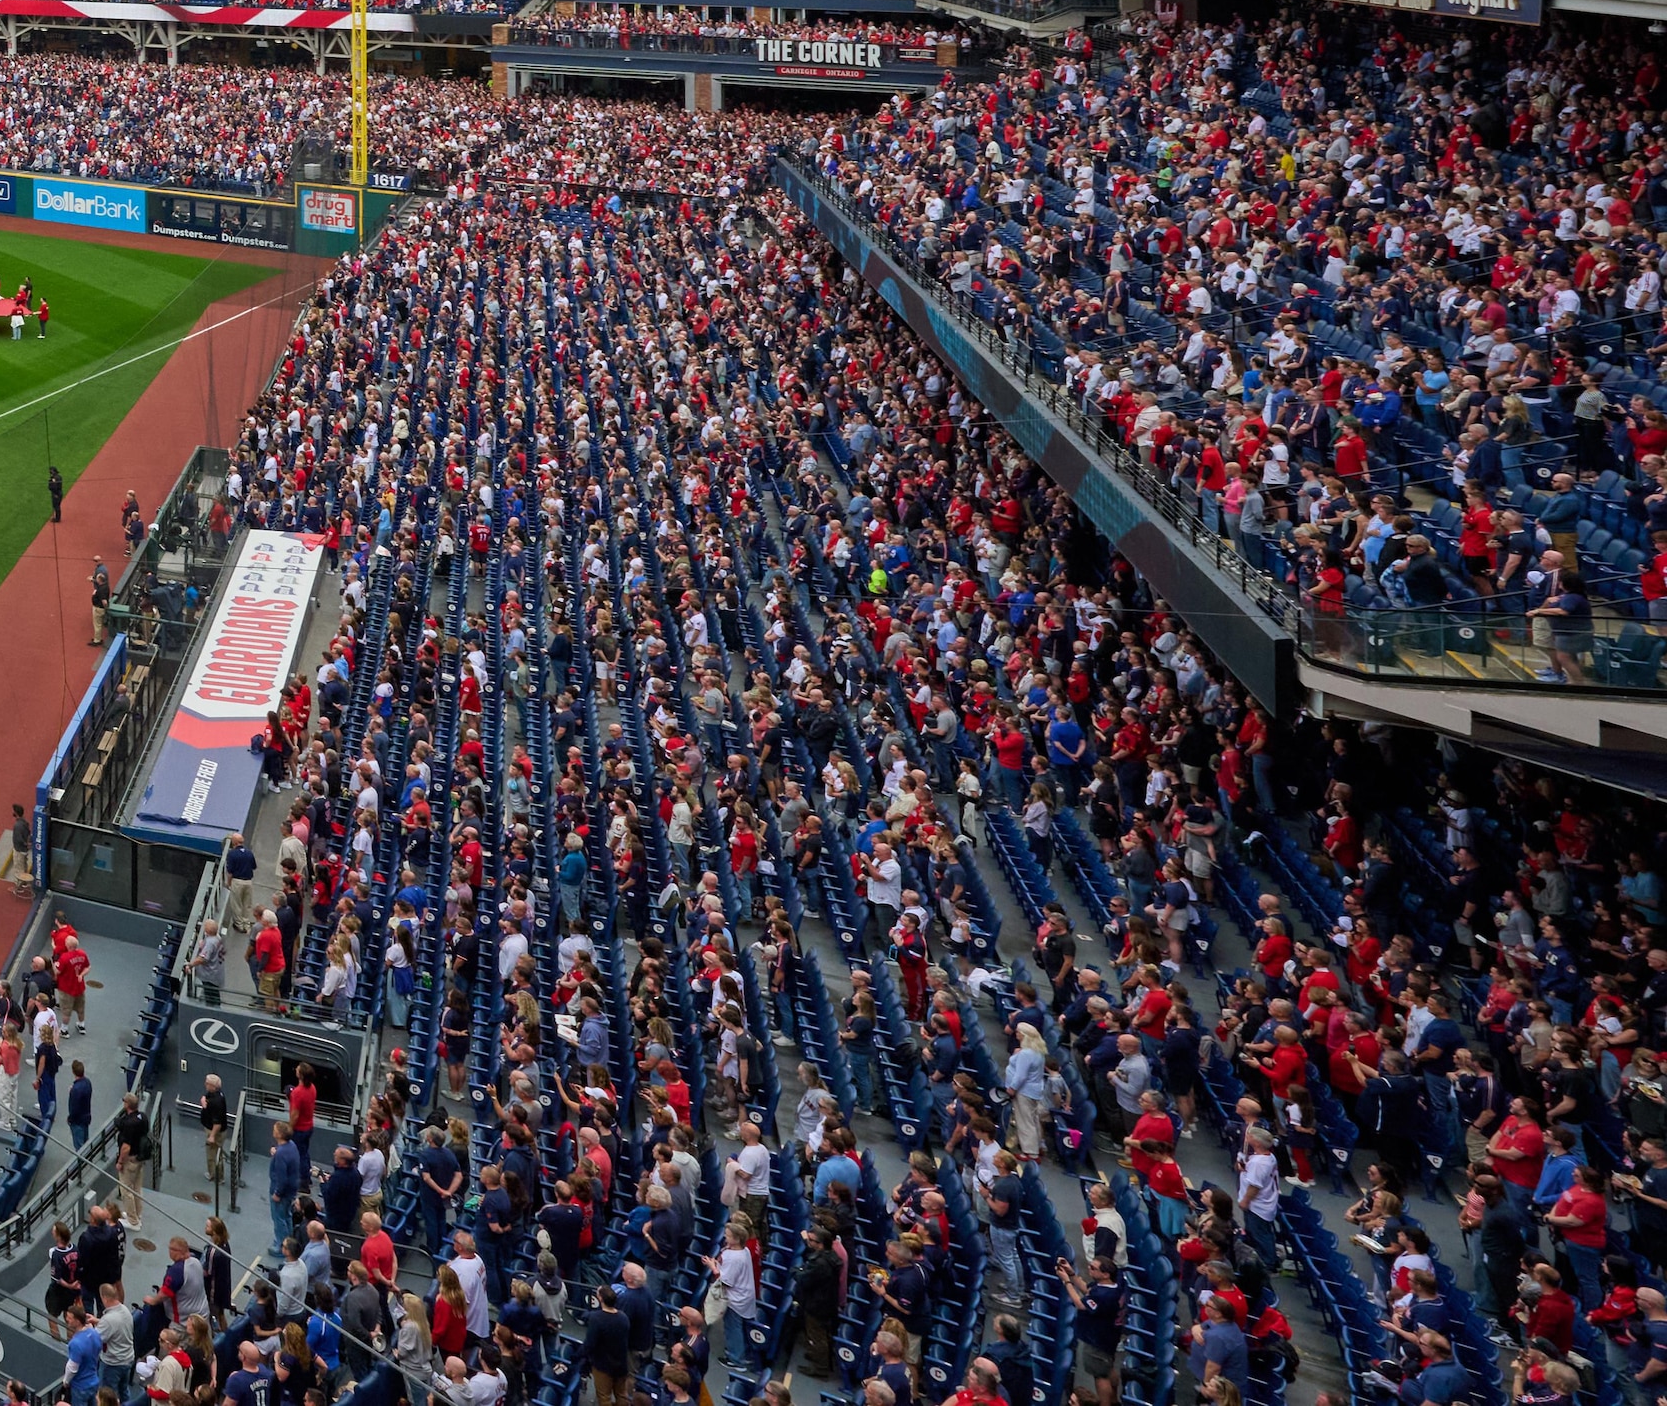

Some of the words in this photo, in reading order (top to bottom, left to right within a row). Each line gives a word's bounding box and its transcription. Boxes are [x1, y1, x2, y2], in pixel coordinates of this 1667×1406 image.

[756, 39, 793, 63] THE
[798, 42, 882, 68] CORNER
[780, 67, 818, 76] CARNEGIE
[825, 69, 859, 77] ONTARIO
[373, 173, 404, 187] 1617
[36, 188, 140, 221] DollarBank
[305, 194, 346, 216] drug
[309, 211, 355, 229] mart
[153, 224, 217, 242] Dumpsters.com
[221, 232, 289, 250] Dumpsters.com
[194, 595, 300, 706] GUARDIANS
[182, 783, 210, 823] PROGRESSIVE
[199, 759, 219, 786] FIELD
